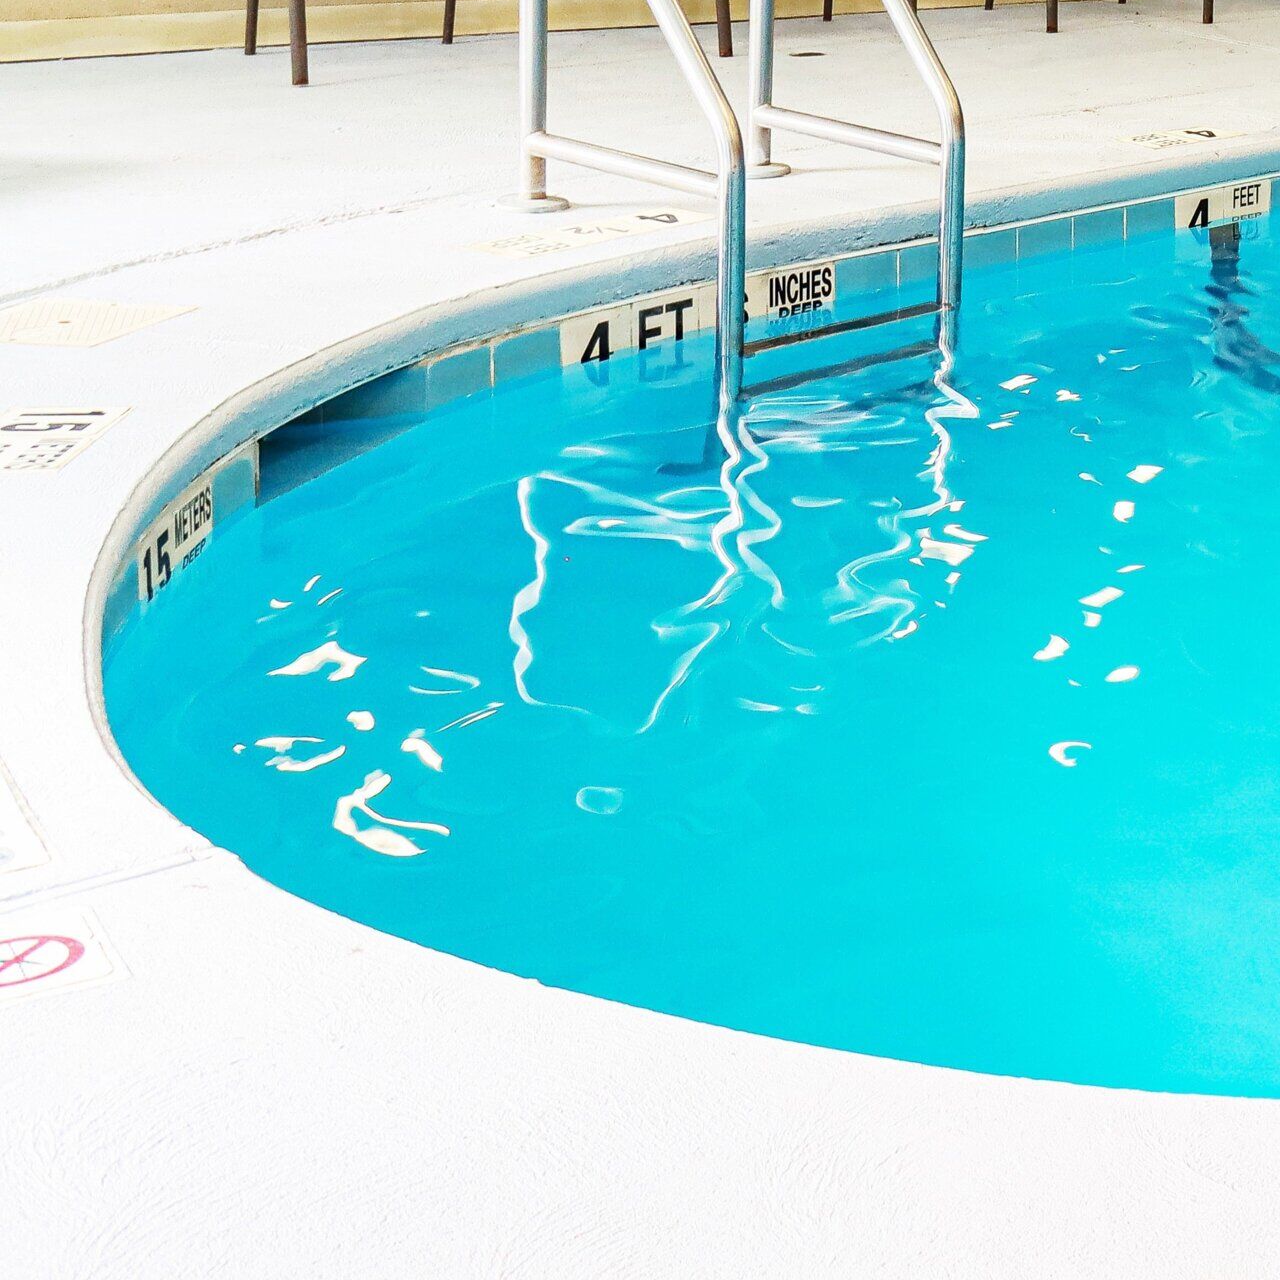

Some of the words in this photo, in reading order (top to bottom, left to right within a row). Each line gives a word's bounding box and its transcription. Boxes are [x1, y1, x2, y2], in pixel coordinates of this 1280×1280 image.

[1188, 198, 1211, 228] 4
[1233, 184, 1261, 209] FEET
[769, 267, 832, 308] INCHES
[580, 320, 614, 364] 4
[638, 298, 693, 350] FT
[174, 486, 212, 548] METERS
[182, 538, 206, 569] DEEP
